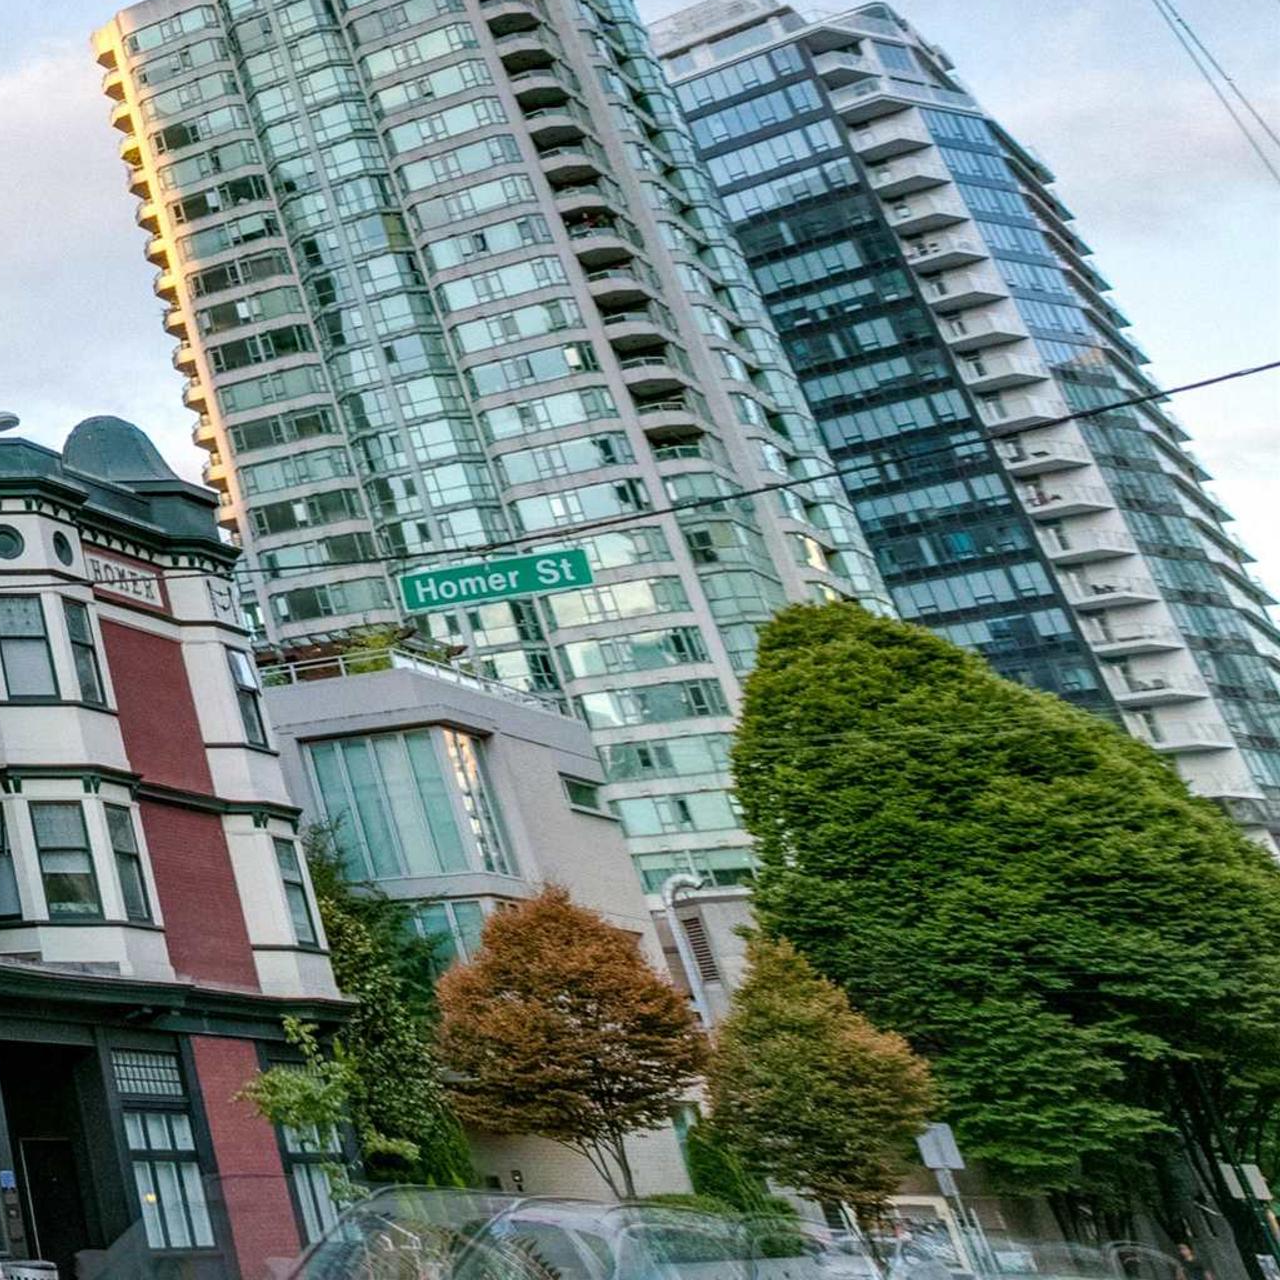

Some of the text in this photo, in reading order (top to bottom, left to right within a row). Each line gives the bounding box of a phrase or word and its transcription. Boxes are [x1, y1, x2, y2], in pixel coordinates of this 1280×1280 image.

[88, 558, 155, 599] HOMER
[414, 558, 577, 603] Homer St
